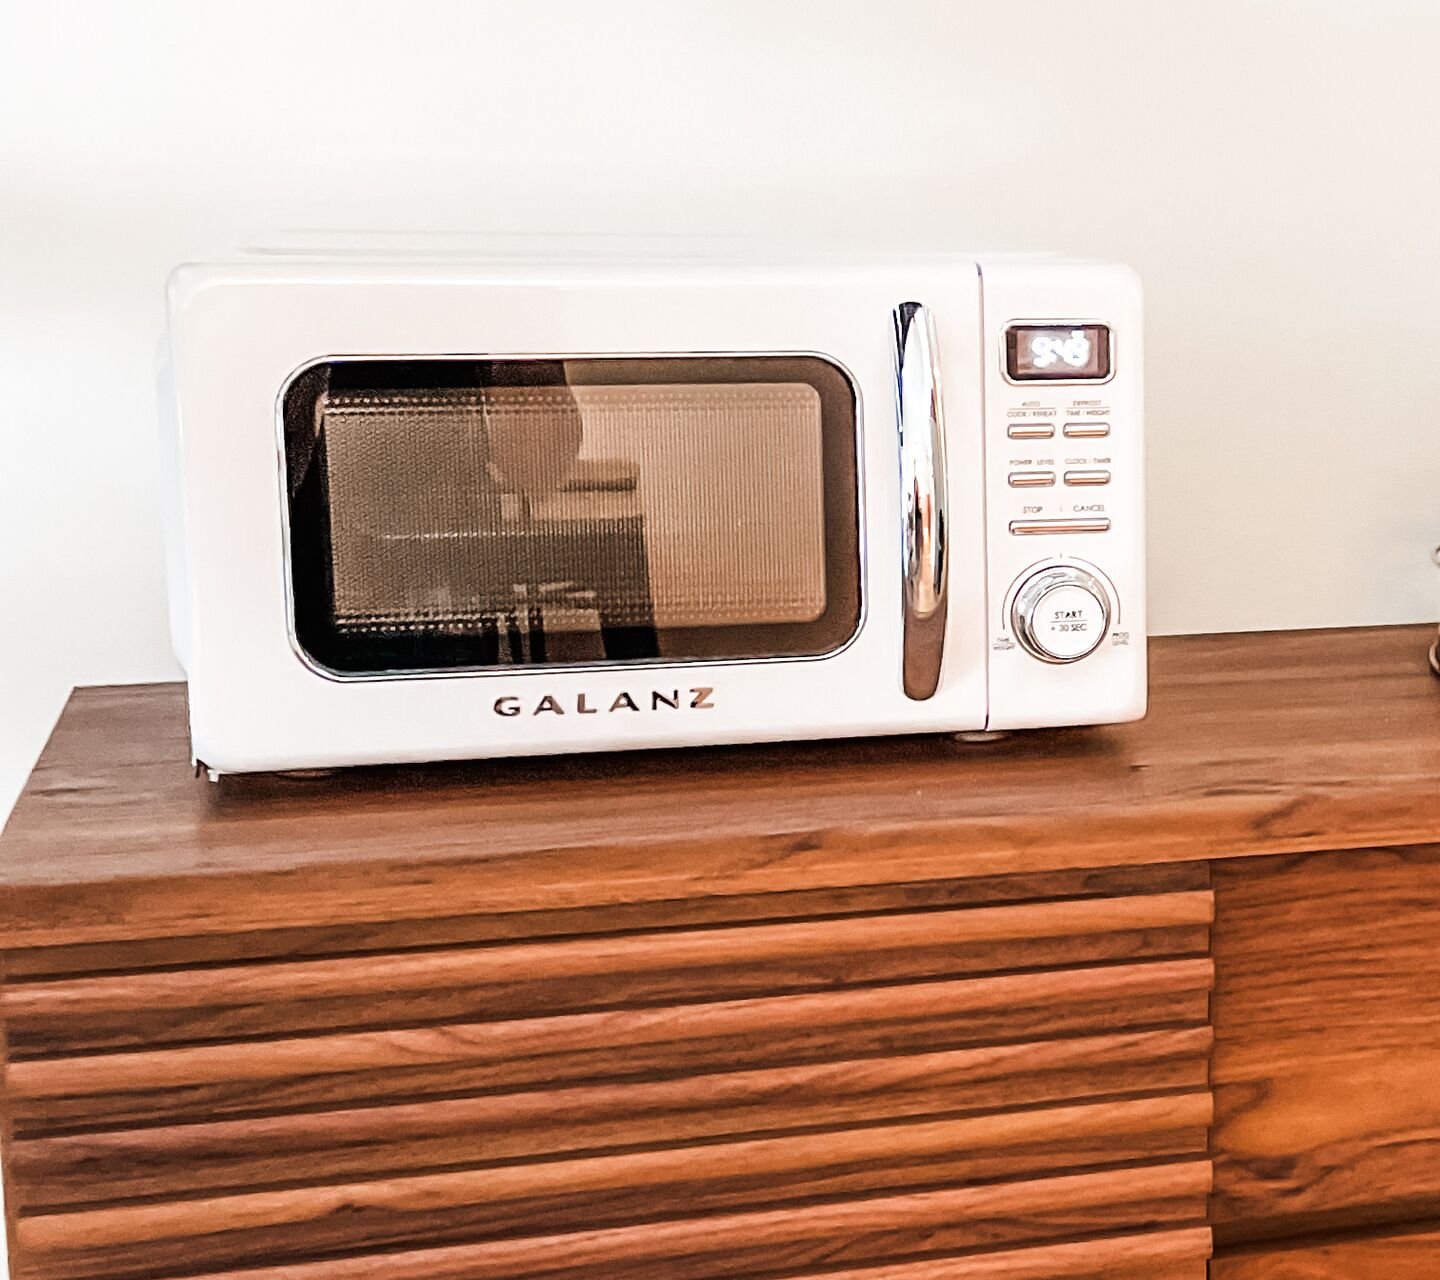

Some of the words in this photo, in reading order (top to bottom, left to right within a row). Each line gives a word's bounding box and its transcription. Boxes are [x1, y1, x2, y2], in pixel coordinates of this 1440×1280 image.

[1022, 506, 1043, 514] STOP
[1072, 504, 1105, 512] CANCEL
[1054, 610, 1083, 620] START
[1070, 623, 1088, 632] SEC
[493, 687, 715, 717] GALANZ
